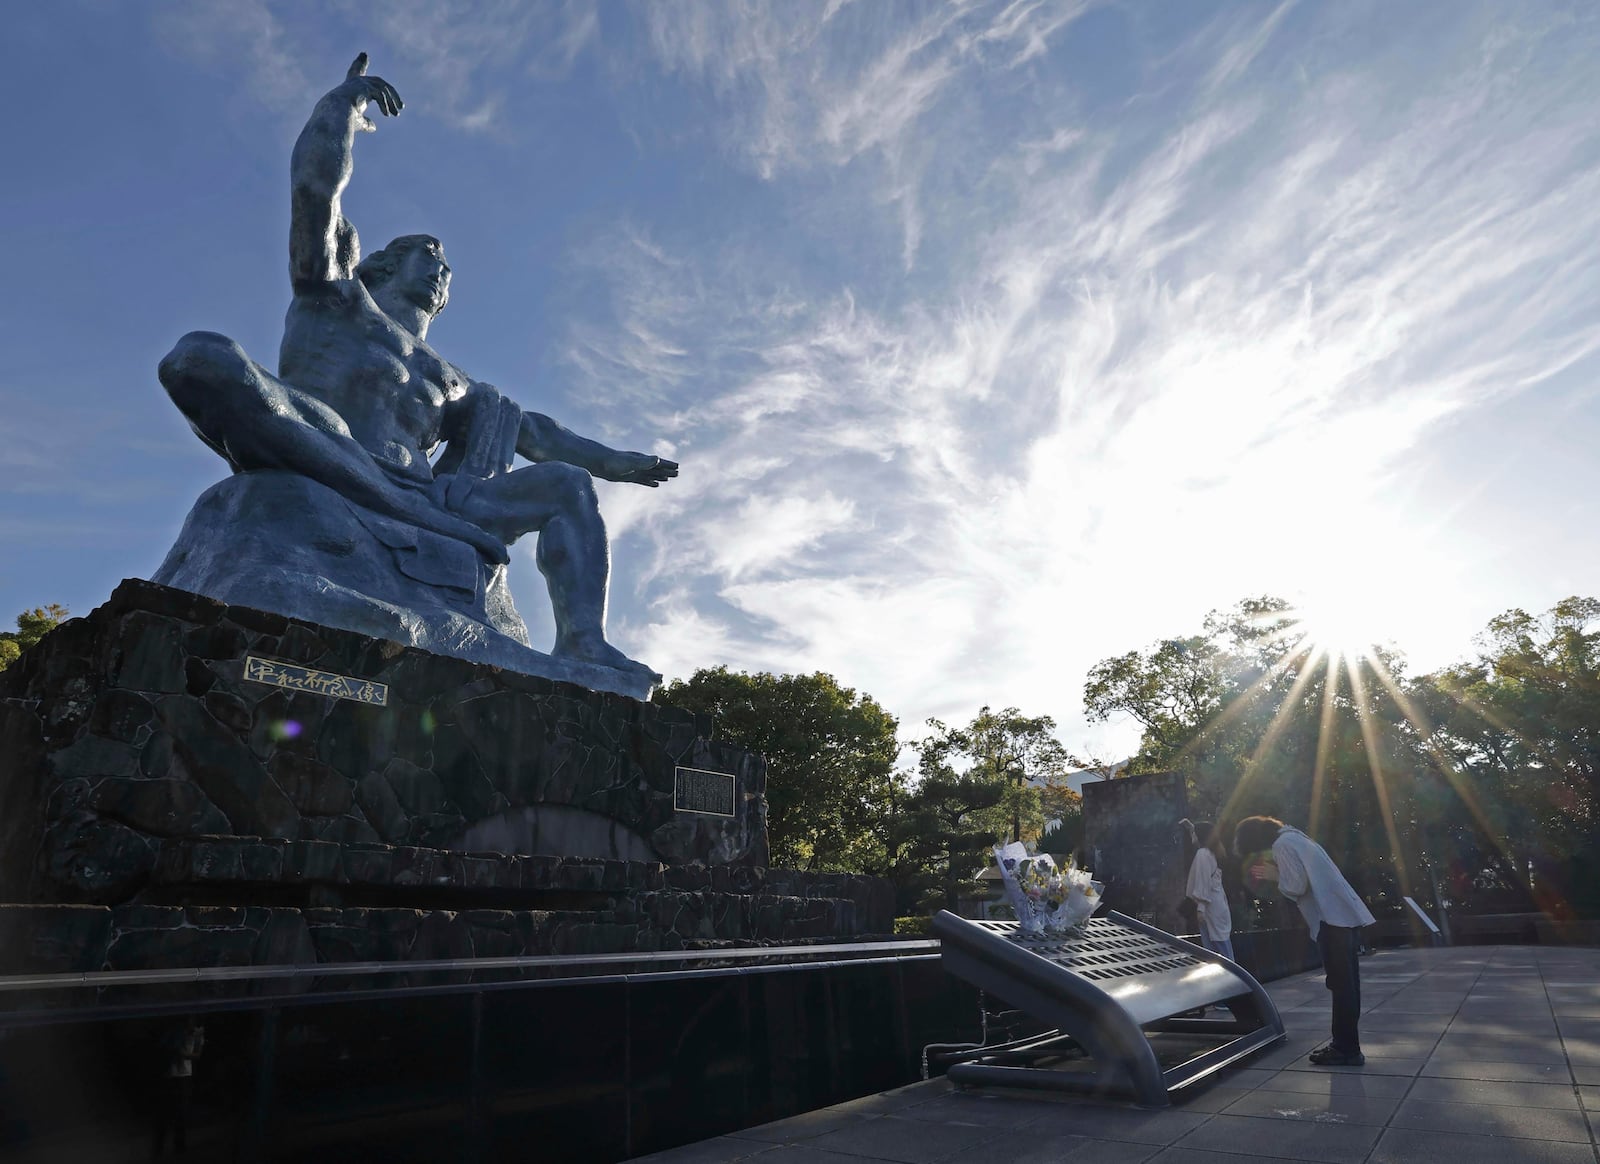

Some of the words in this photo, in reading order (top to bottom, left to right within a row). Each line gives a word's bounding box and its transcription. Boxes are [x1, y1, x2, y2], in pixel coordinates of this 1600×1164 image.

[250, 660, 383, 702] 平和祈念像
